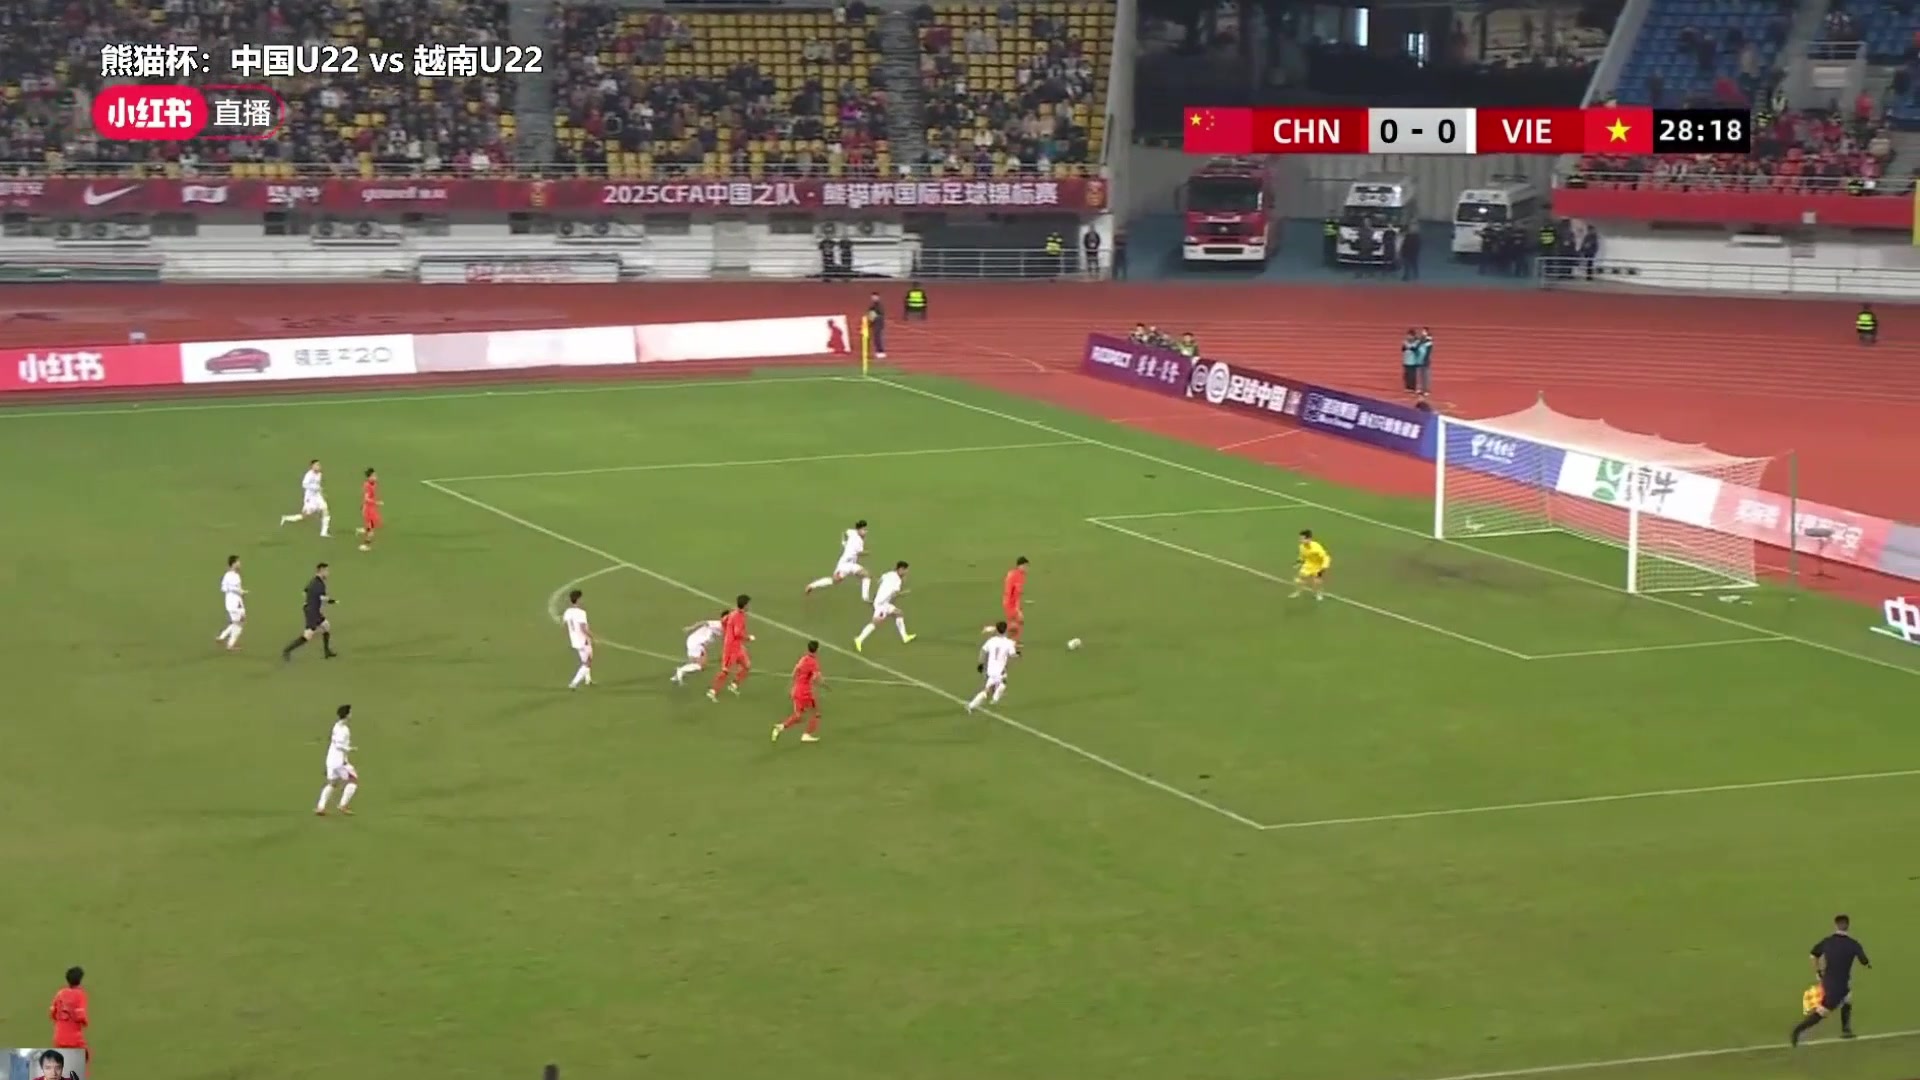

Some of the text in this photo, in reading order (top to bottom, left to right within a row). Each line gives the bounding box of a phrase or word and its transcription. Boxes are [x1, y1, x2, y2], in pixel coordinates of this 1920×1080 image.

[18, 351, 105, 383] 小红书
[1226, 374, 1288, 412] 足球中国
